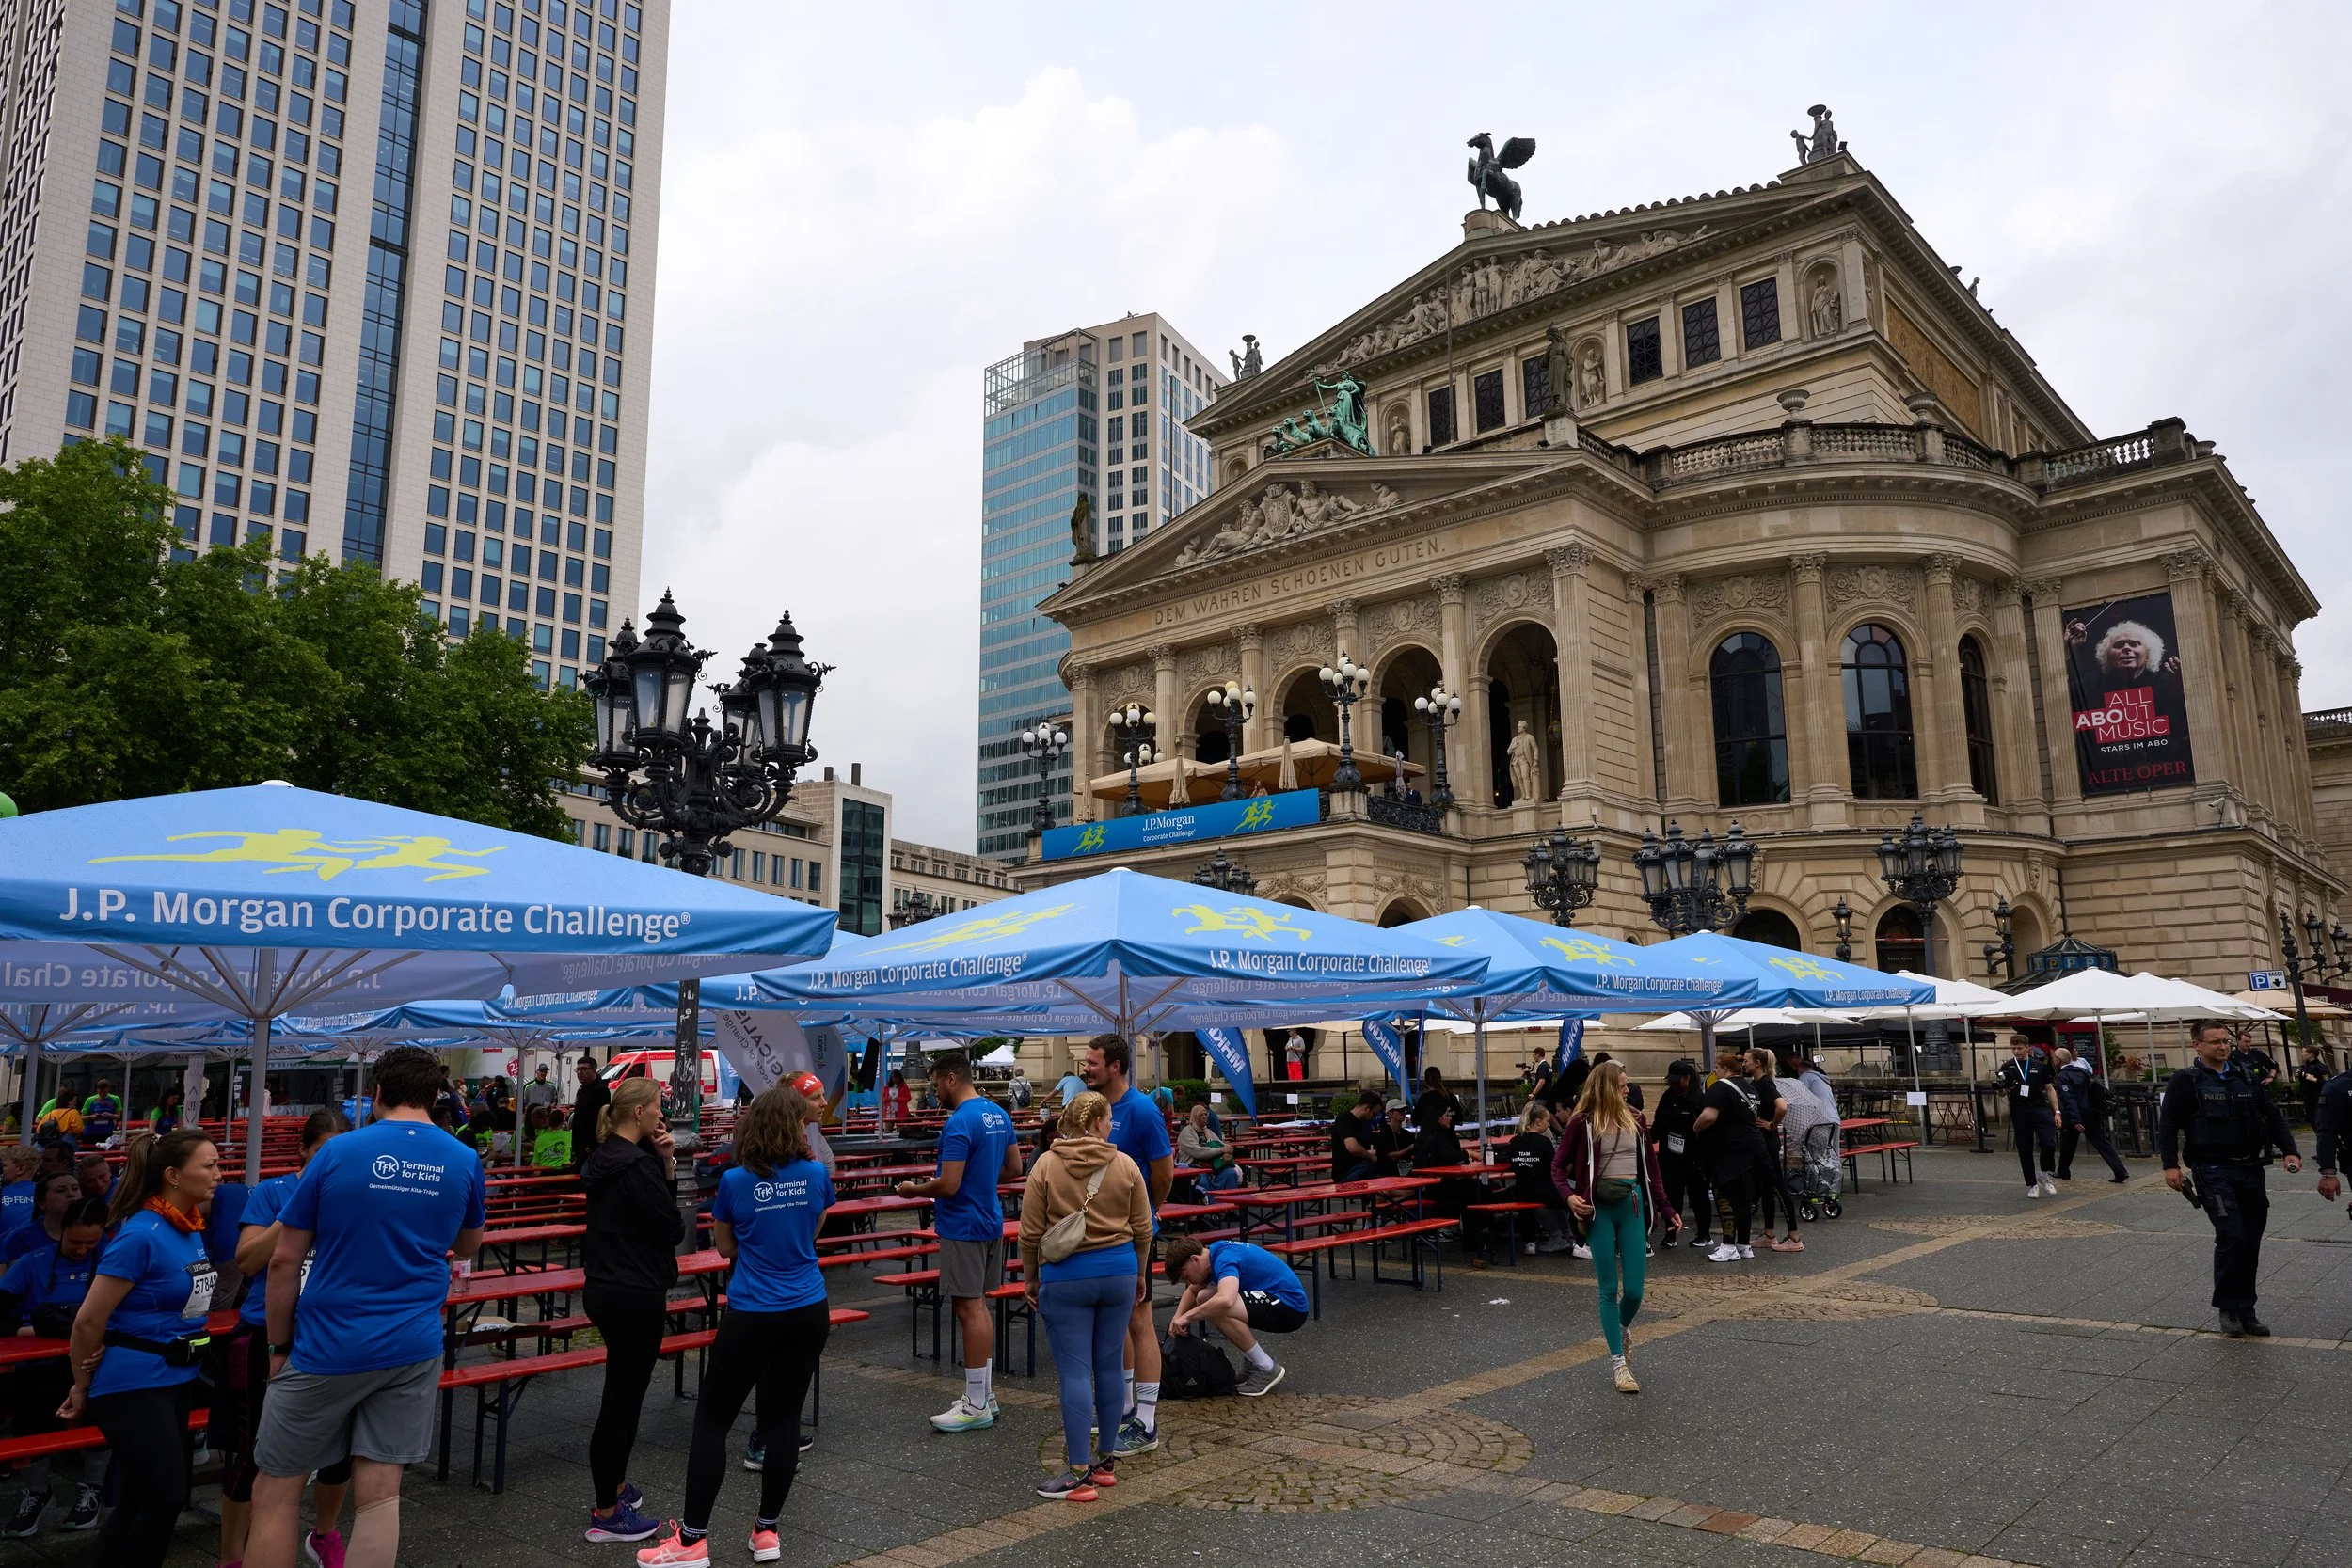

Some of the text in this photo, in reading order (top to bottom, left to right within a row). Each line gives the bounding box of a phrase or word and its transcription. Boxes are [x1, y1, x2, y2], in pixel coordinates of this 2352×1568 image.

[1154, 537, 1446, 626] DEM WAHREN SCHOENEN GUTEN.
[2109, 689, 2152, 708] ALL
[2075, 704, 2153, 729] ABOUT
[2098, 718, 2168, 741] MUSIC
[2100, 738, 2168, 753] STARS IM ABO
[2089, 761, 2187, 784] ALTE OPER
[1142, 814, 1195, 832] J.P.Morgan
[1143, 832, 1168, 843] Corporate
[59, 887, 136, 923] J.P.
[153, 891, 313, 934] Morgan
[328, 897, 513, 937] Corporate
[1209, 949, 1235, 971] J.P.
[1238, 950, 1294, 975] Morgan
[1297, 952, 1365, 976] Corporate
[807, 972, 828, 990] J.P.
[832, 967, 877, 990] Morgan
[880, 959, 946, 986] Corporate
[2256, 976, 2265, 989] P
[1596, 974, 1609, 989] J.P.
[1612, 974, 1644, 992] Morgan
[1645, 976, 1684, 995] Corporate
[535, 992, 565, 1008] Corporate
[1836, 989, 1855, 1003] Morgan
[1857, 989, 1884, 1003] Corporate
[401, 1160, 445, 1174] Terminal
[402, 1169, 441, 1182] for Kids
[774, 1179, 807, 1190] Terminal
[788, 1187, 806, 1196] Kids
